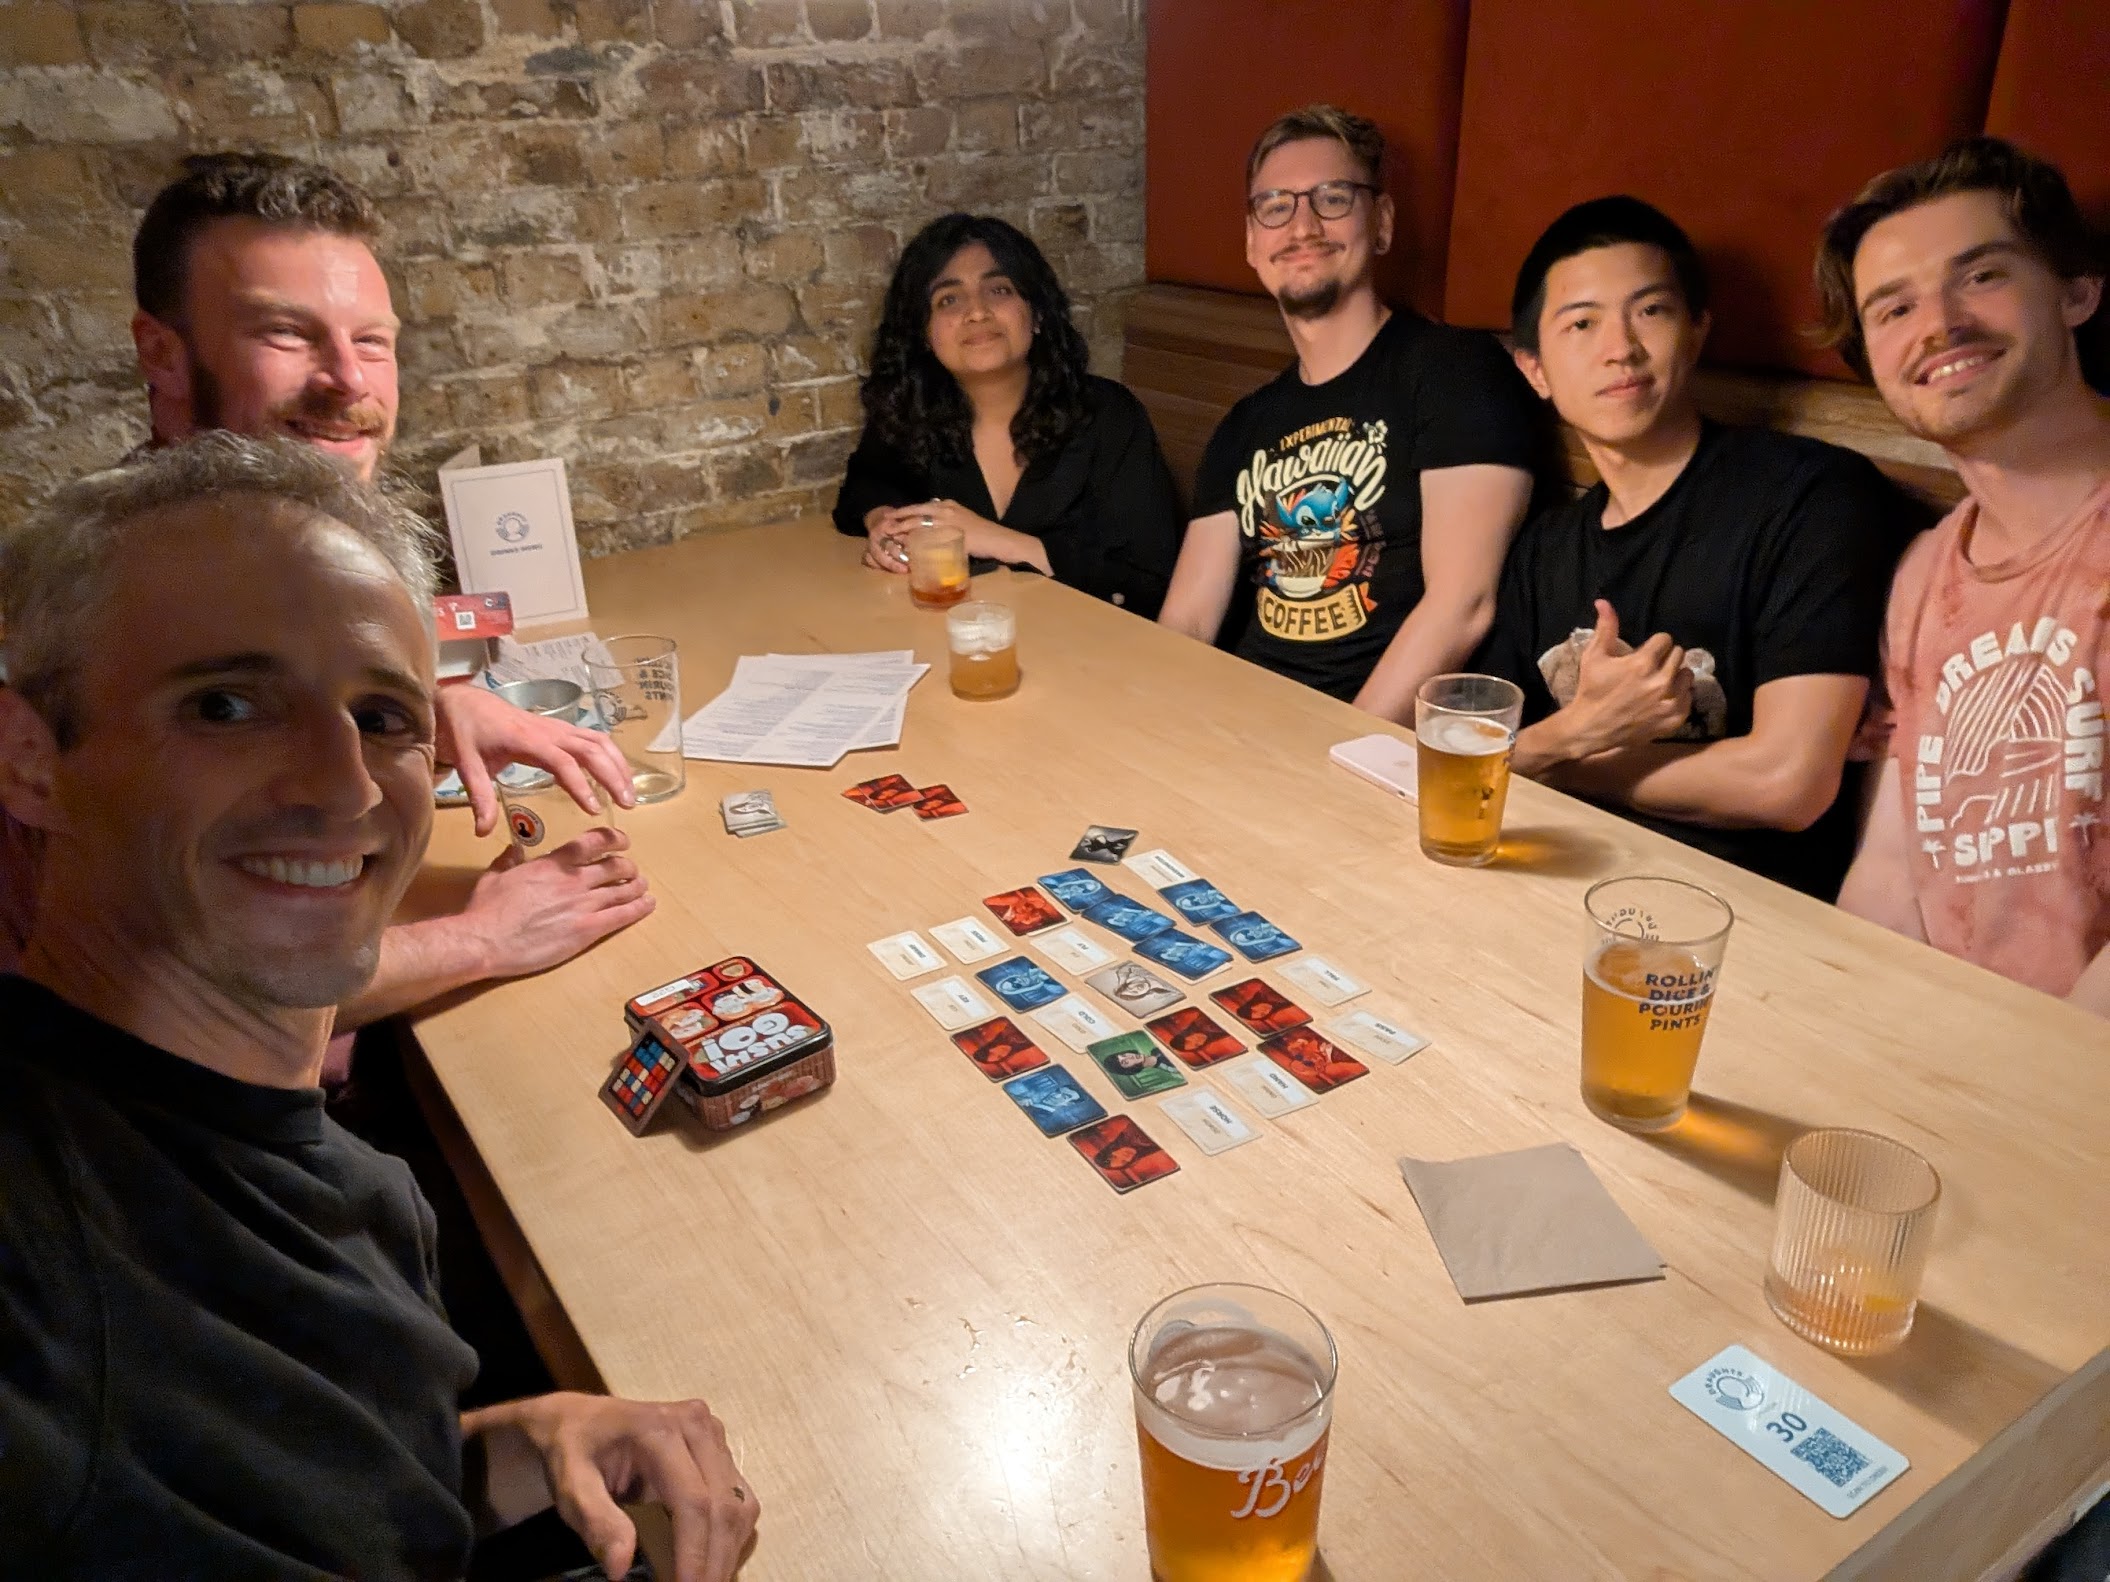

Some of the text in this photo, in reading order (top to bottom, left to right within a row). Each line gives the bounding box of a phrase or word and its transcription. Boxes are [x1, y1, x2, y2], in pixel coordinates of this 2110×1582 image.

[1263, 598, 1346, 636] COFFEE
[1954, 817, 2058, 867] SPPI
[1649, 987, 1698, 1001] DICE
[1078, 1011, 1096, 1024] COLD
[1650, 1015, 1701, 1031] PINTS
[702, 1012, 789, 1061] GO!
[709, 1024, 808, 1074] SUSHI
[1269, 1073, 1289, 1089] HAND
[1209, 1105, 1232, 1124] HORSE
[1766, 1411, 1808, 1443] 30
